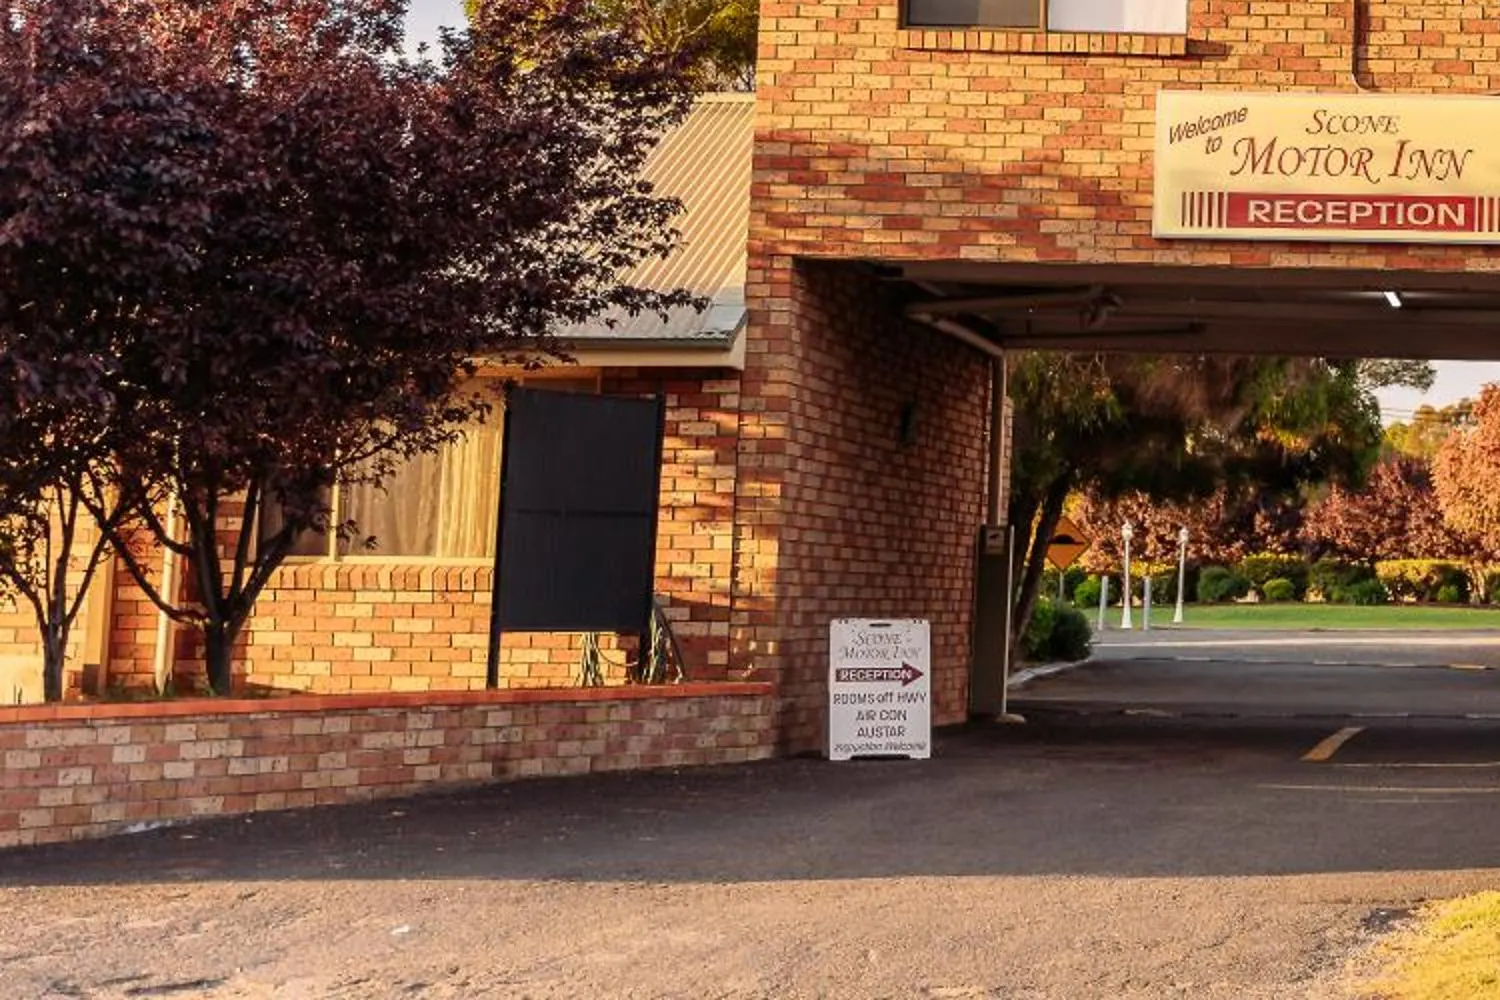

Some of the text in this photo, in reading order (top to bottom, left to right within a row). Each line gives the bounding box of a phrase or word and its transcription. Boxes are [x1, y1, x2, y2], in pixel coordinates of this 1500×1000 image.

[1168, 106, 1249, 145] Welcome
[1204, 136, 1223, 155] to
[1229, 136, 1474, 184] MOTOR INN
[1247, 199, 1466, 226] RECEPTION
[841, 669, 913, 680] RECEPTION
[833, 692, 875, 705] ROOMS
[897, 692, 927, 703] HWY
[856, 709, 907, 721] AIR CON
[857, 725, 906, 738] AUSTAR
